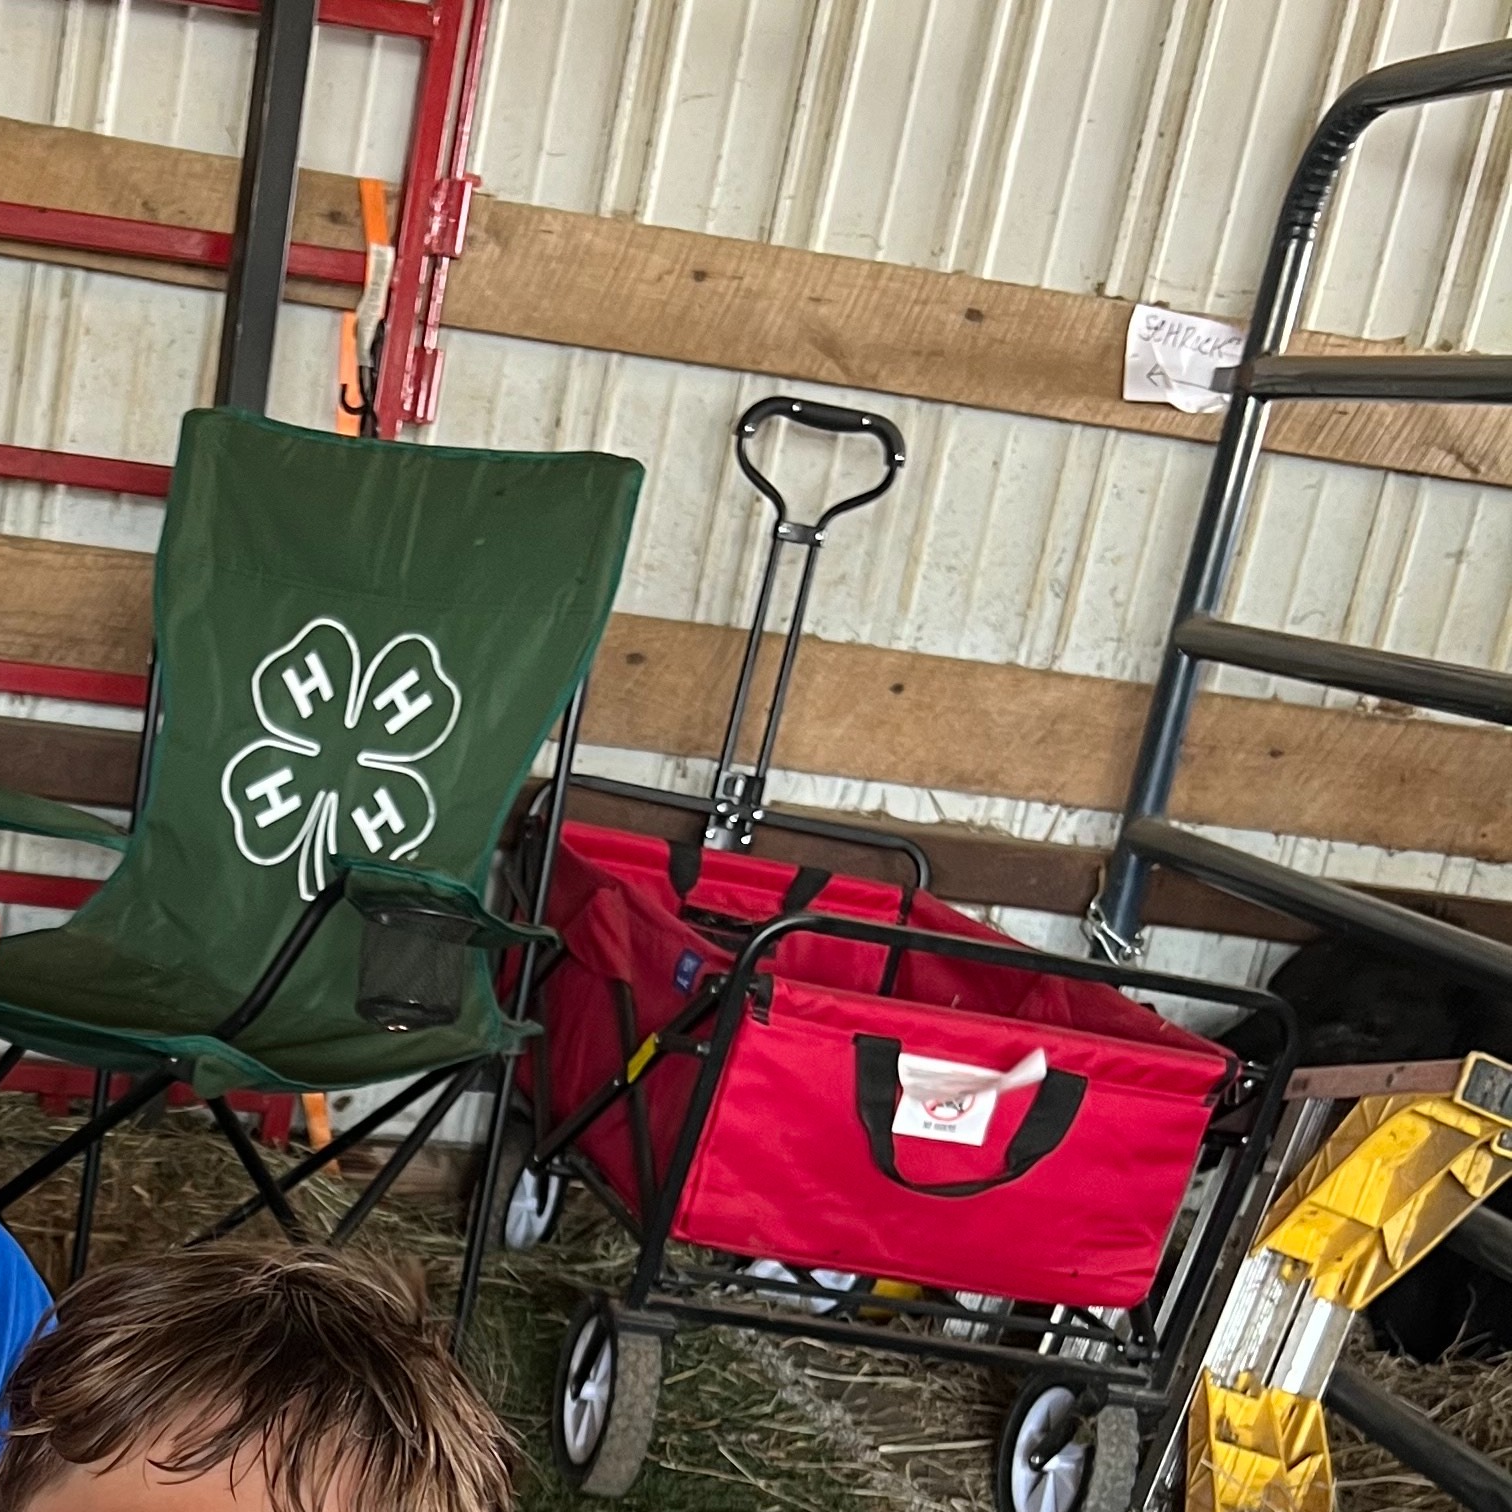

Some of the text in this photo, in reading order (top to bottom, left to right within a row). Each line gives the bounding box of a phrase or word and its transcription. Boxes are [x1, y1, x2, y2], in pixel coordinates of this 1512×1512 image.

[281, 649, 334, 719] H
[373, 667, 433, 735] H
[245, 766, 302, 829] H
[351, 786, 406, 854] H
